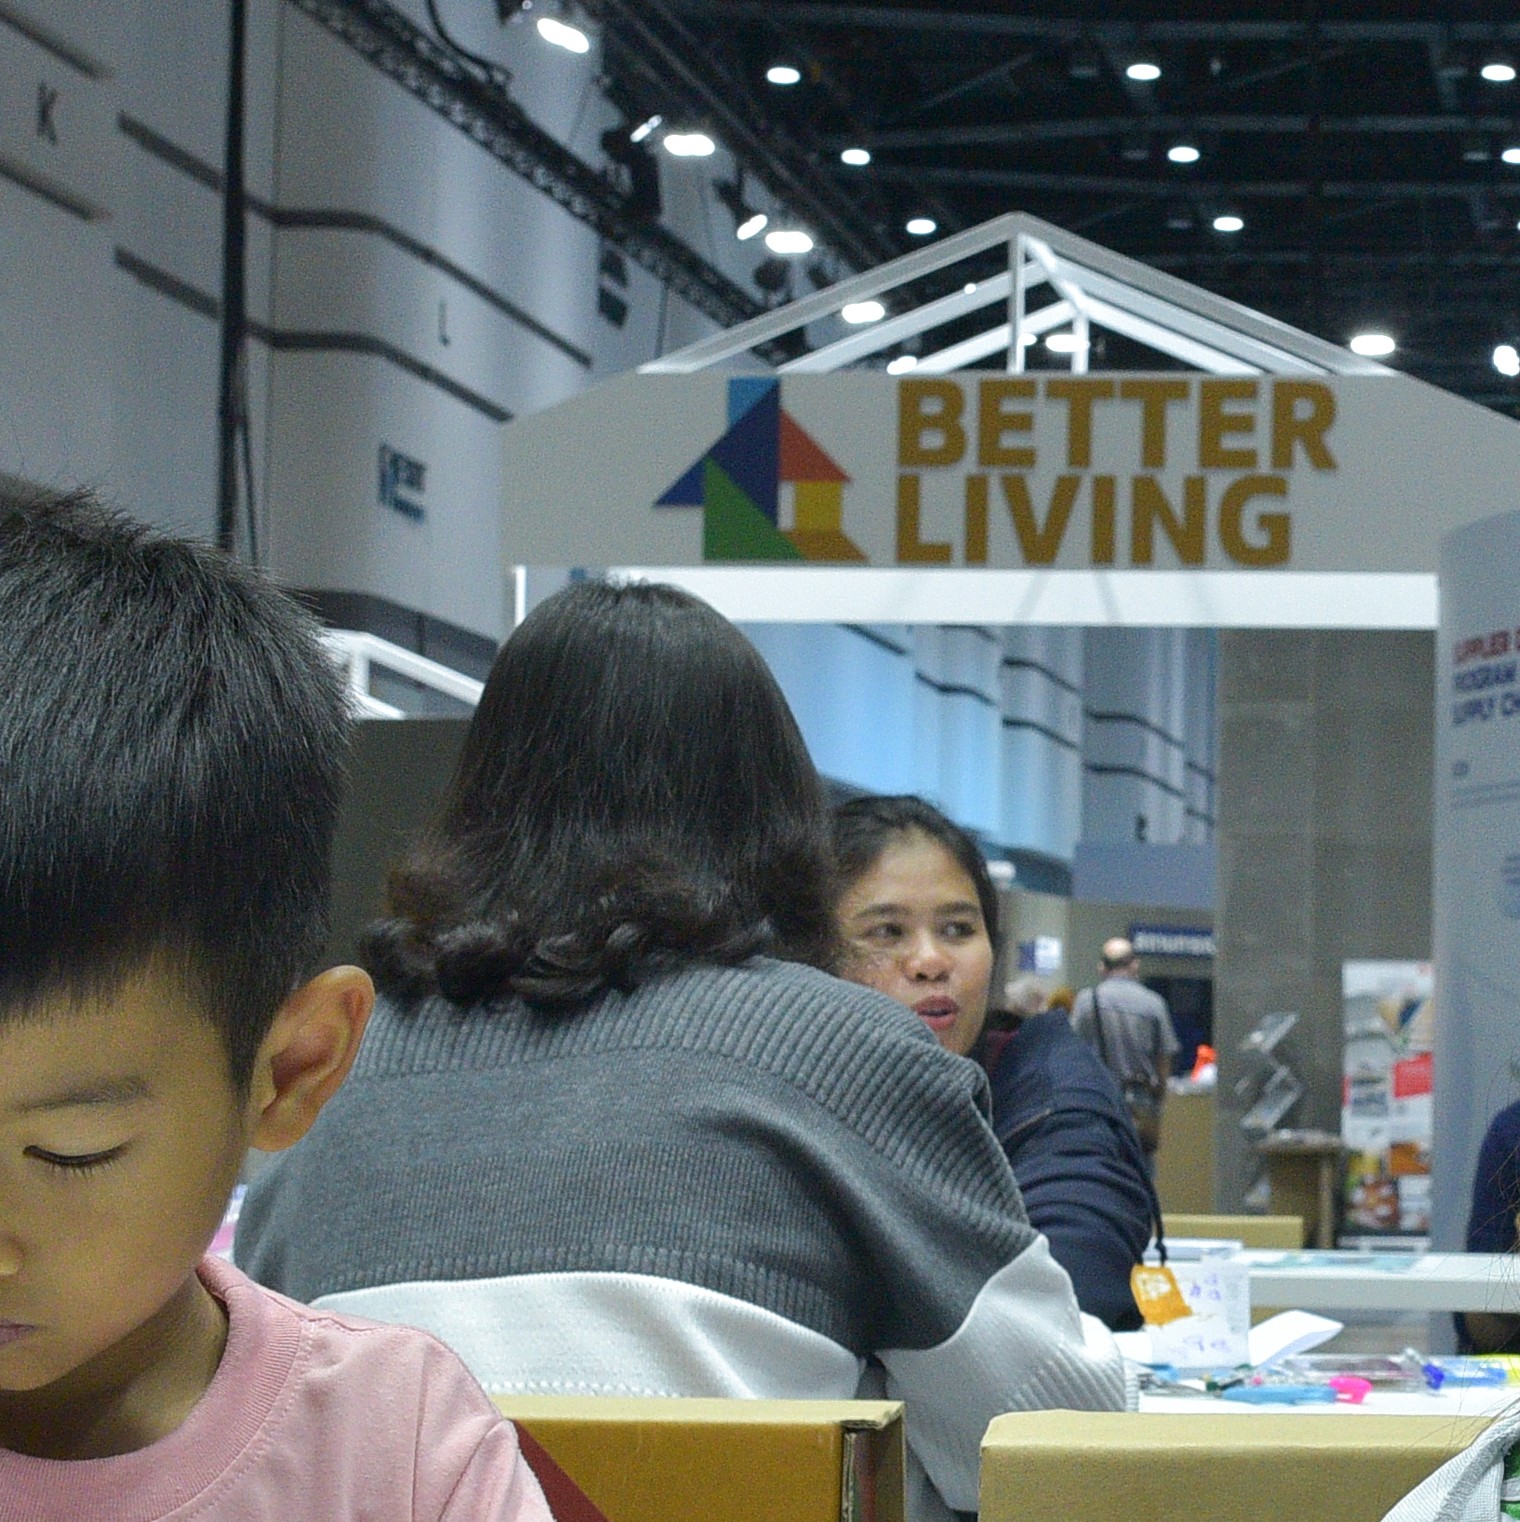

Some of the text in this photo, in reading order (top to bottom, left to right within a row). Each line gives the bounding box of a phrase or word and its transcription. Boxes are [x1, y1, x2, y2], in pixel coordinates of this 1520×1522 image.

[36, 82, 58, 144] K
[895, 377, 1339, 471] BETTER
[894, 474, 1292, 568] LIVING
